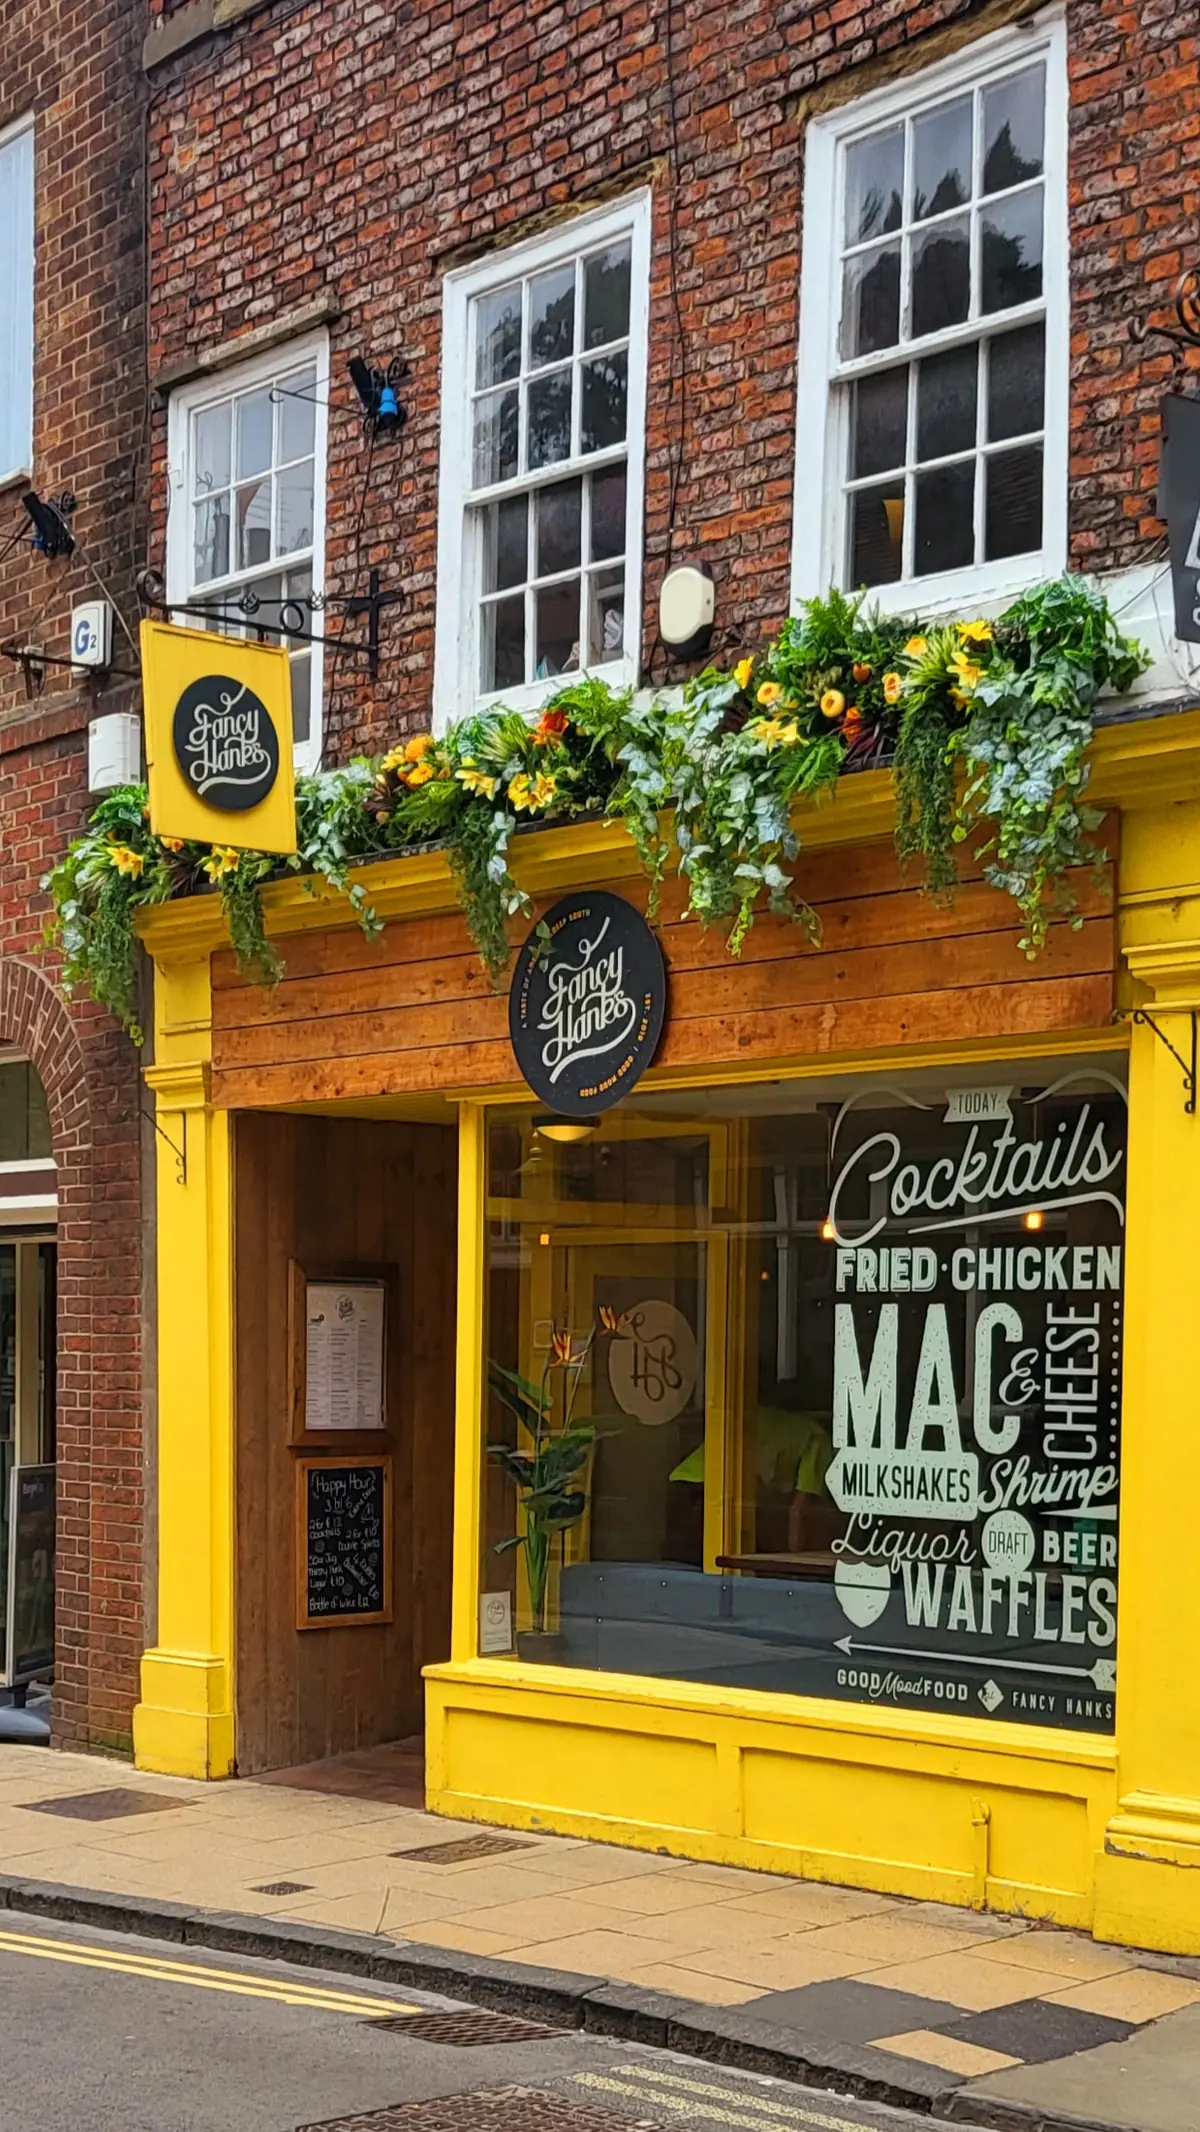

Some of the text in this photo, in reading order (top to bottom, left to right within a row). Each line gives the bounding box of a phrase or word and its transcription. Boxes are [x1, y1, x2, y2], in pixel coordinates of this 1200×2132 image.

[189, 684, 259, 745] Fancy
[542, 922, 623, 1020] Fancy
[956, 1093, 998, 1115] TODAY
[829, 1104, 1123, 1248] Cocktails
[835, 1245, 1121, 1293] FRIED CHICKEN
[832, 1303, 1041, 1455] MAC &
[1043, 1303, 1100, 1460] CHEESE
[316, 1472, 371, 1497] Happy Hour
[842, 1463, 971, 1503] MILKSHAKES
[977, 1454, 1118, 1513] Shrimp
[831, 1510, 977, 1574] Liquor
[988, 1530, 1117, 1568] DRAFT BEER
[309, 1596, 329, 1611] Bottle
[900, 1561, 1117, 1647] WAFFLES
[837, 1668, 881, 1690] GOOD
[868, 1671, 924, 1700] Mood
[924, 1680, 968, 1701] FOOD
[1012, 1691, 1055, 1712] FANCY
[1066, 1696, 1112, 1719] HANKS
